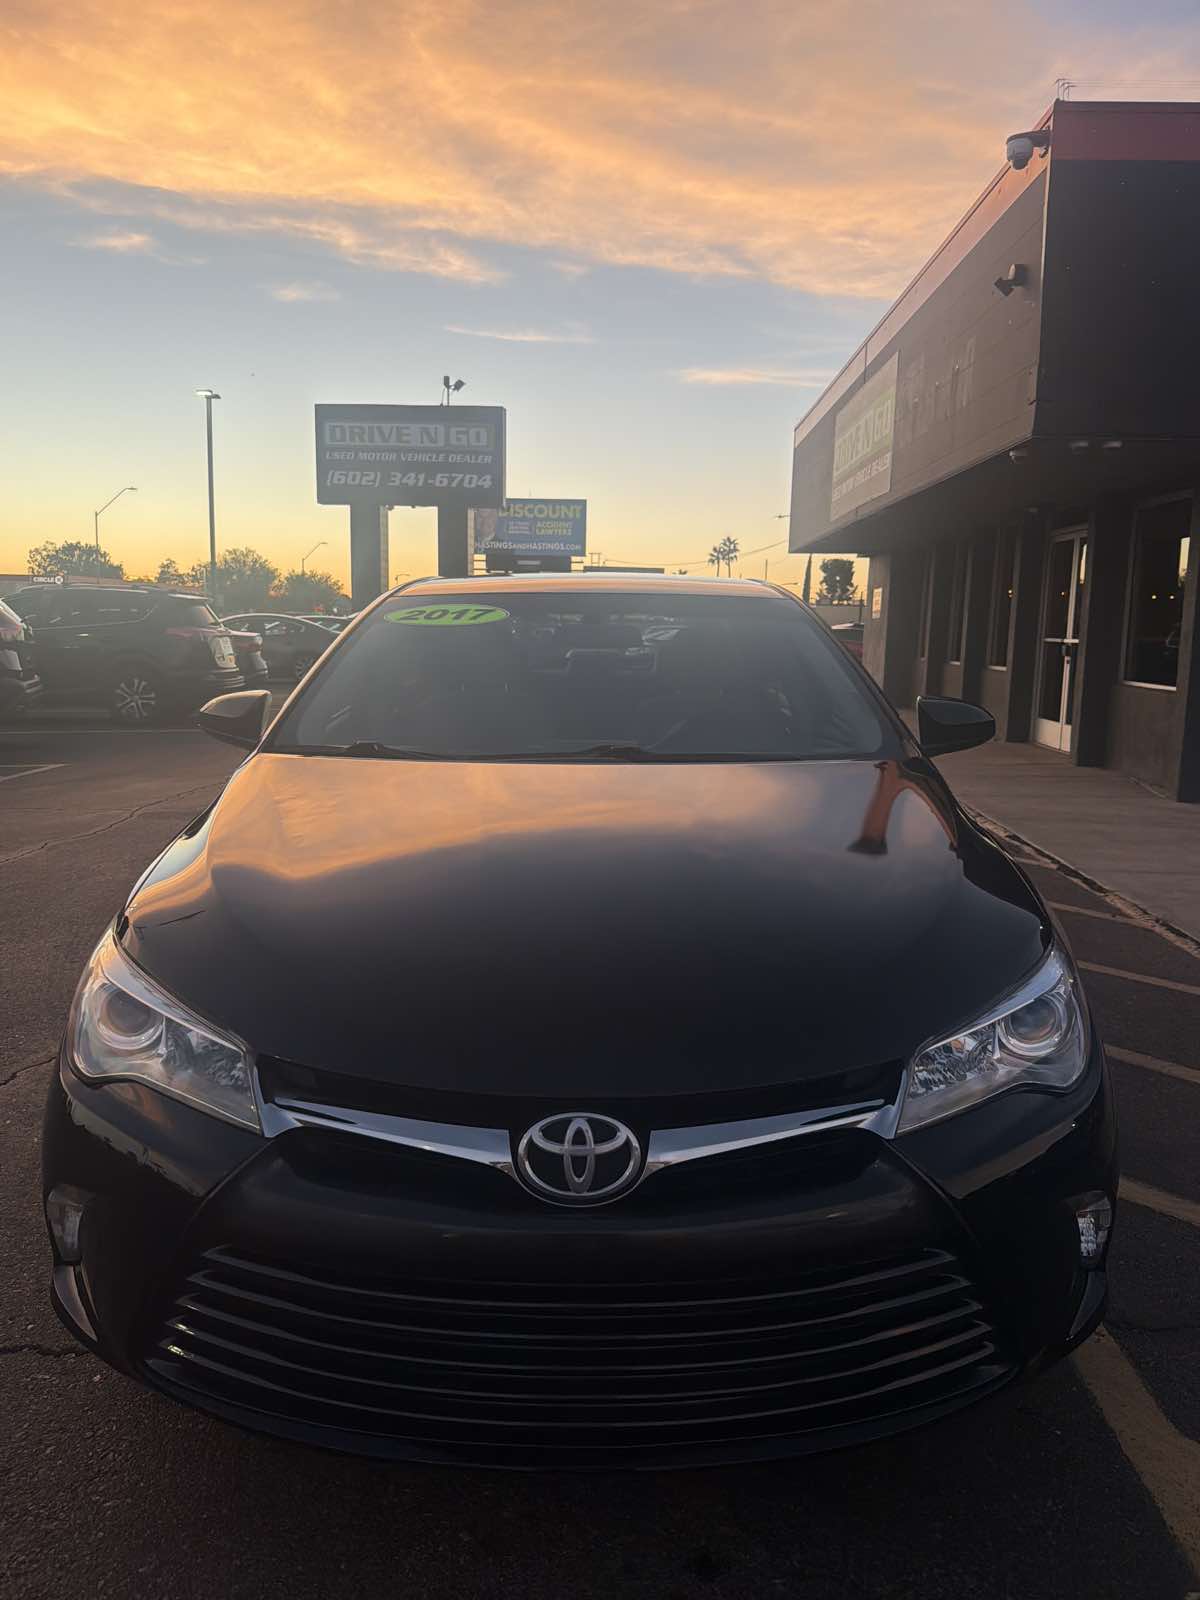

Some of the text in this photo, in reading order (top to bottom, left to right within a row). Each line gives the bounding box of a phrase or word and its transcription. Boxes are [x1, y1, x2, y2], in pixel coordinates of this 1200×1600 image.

[328, 424, 489, 447] DRIVE N GO
[326, 450, 493, 464] USED MOTOR VEHICLE DEALER
[326, 470, 493, 489] (602) 341-6704
[399, 608, 496, 621] 2017
